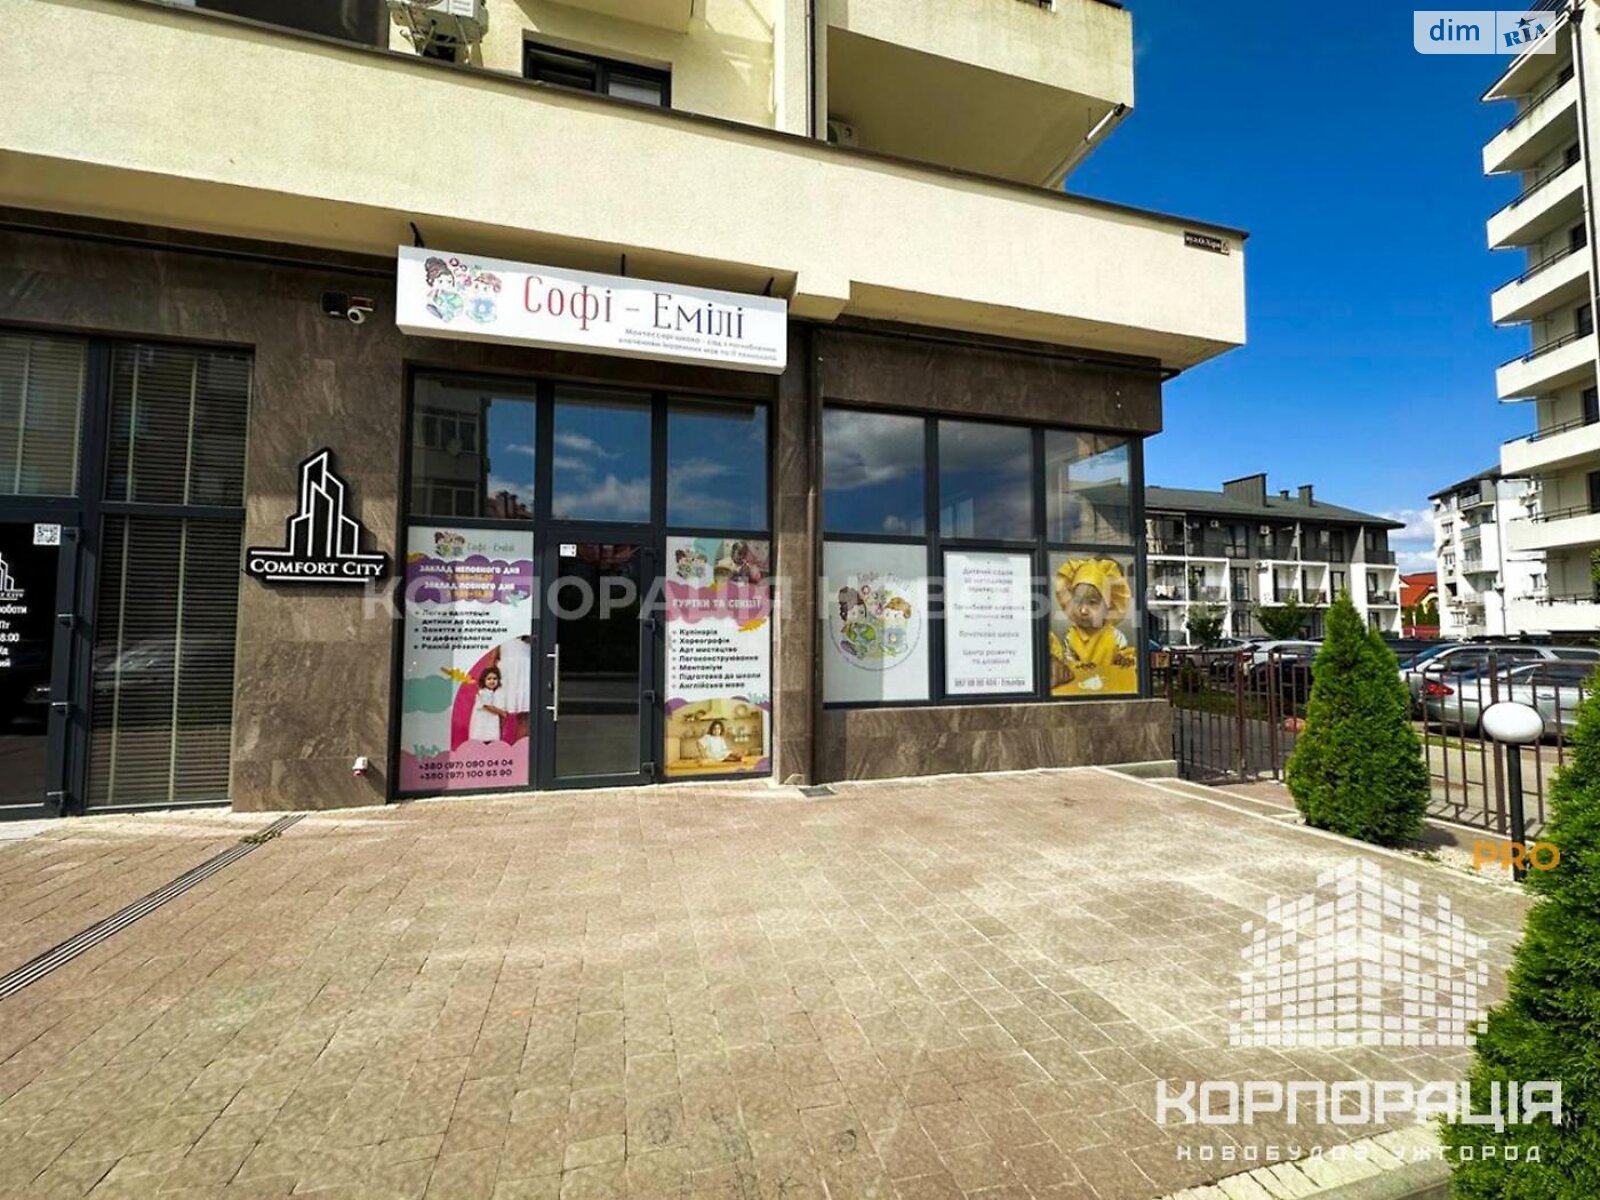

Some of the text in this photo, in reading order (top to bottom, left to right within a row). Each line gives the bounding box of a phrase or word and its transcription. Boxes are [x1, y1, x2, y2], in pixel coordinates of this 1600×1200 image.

[523, 275, 612, 331] Софі
[653, 292, 744, 339] Емілі
[250, 558, 384, 576] COMFORT CITY
